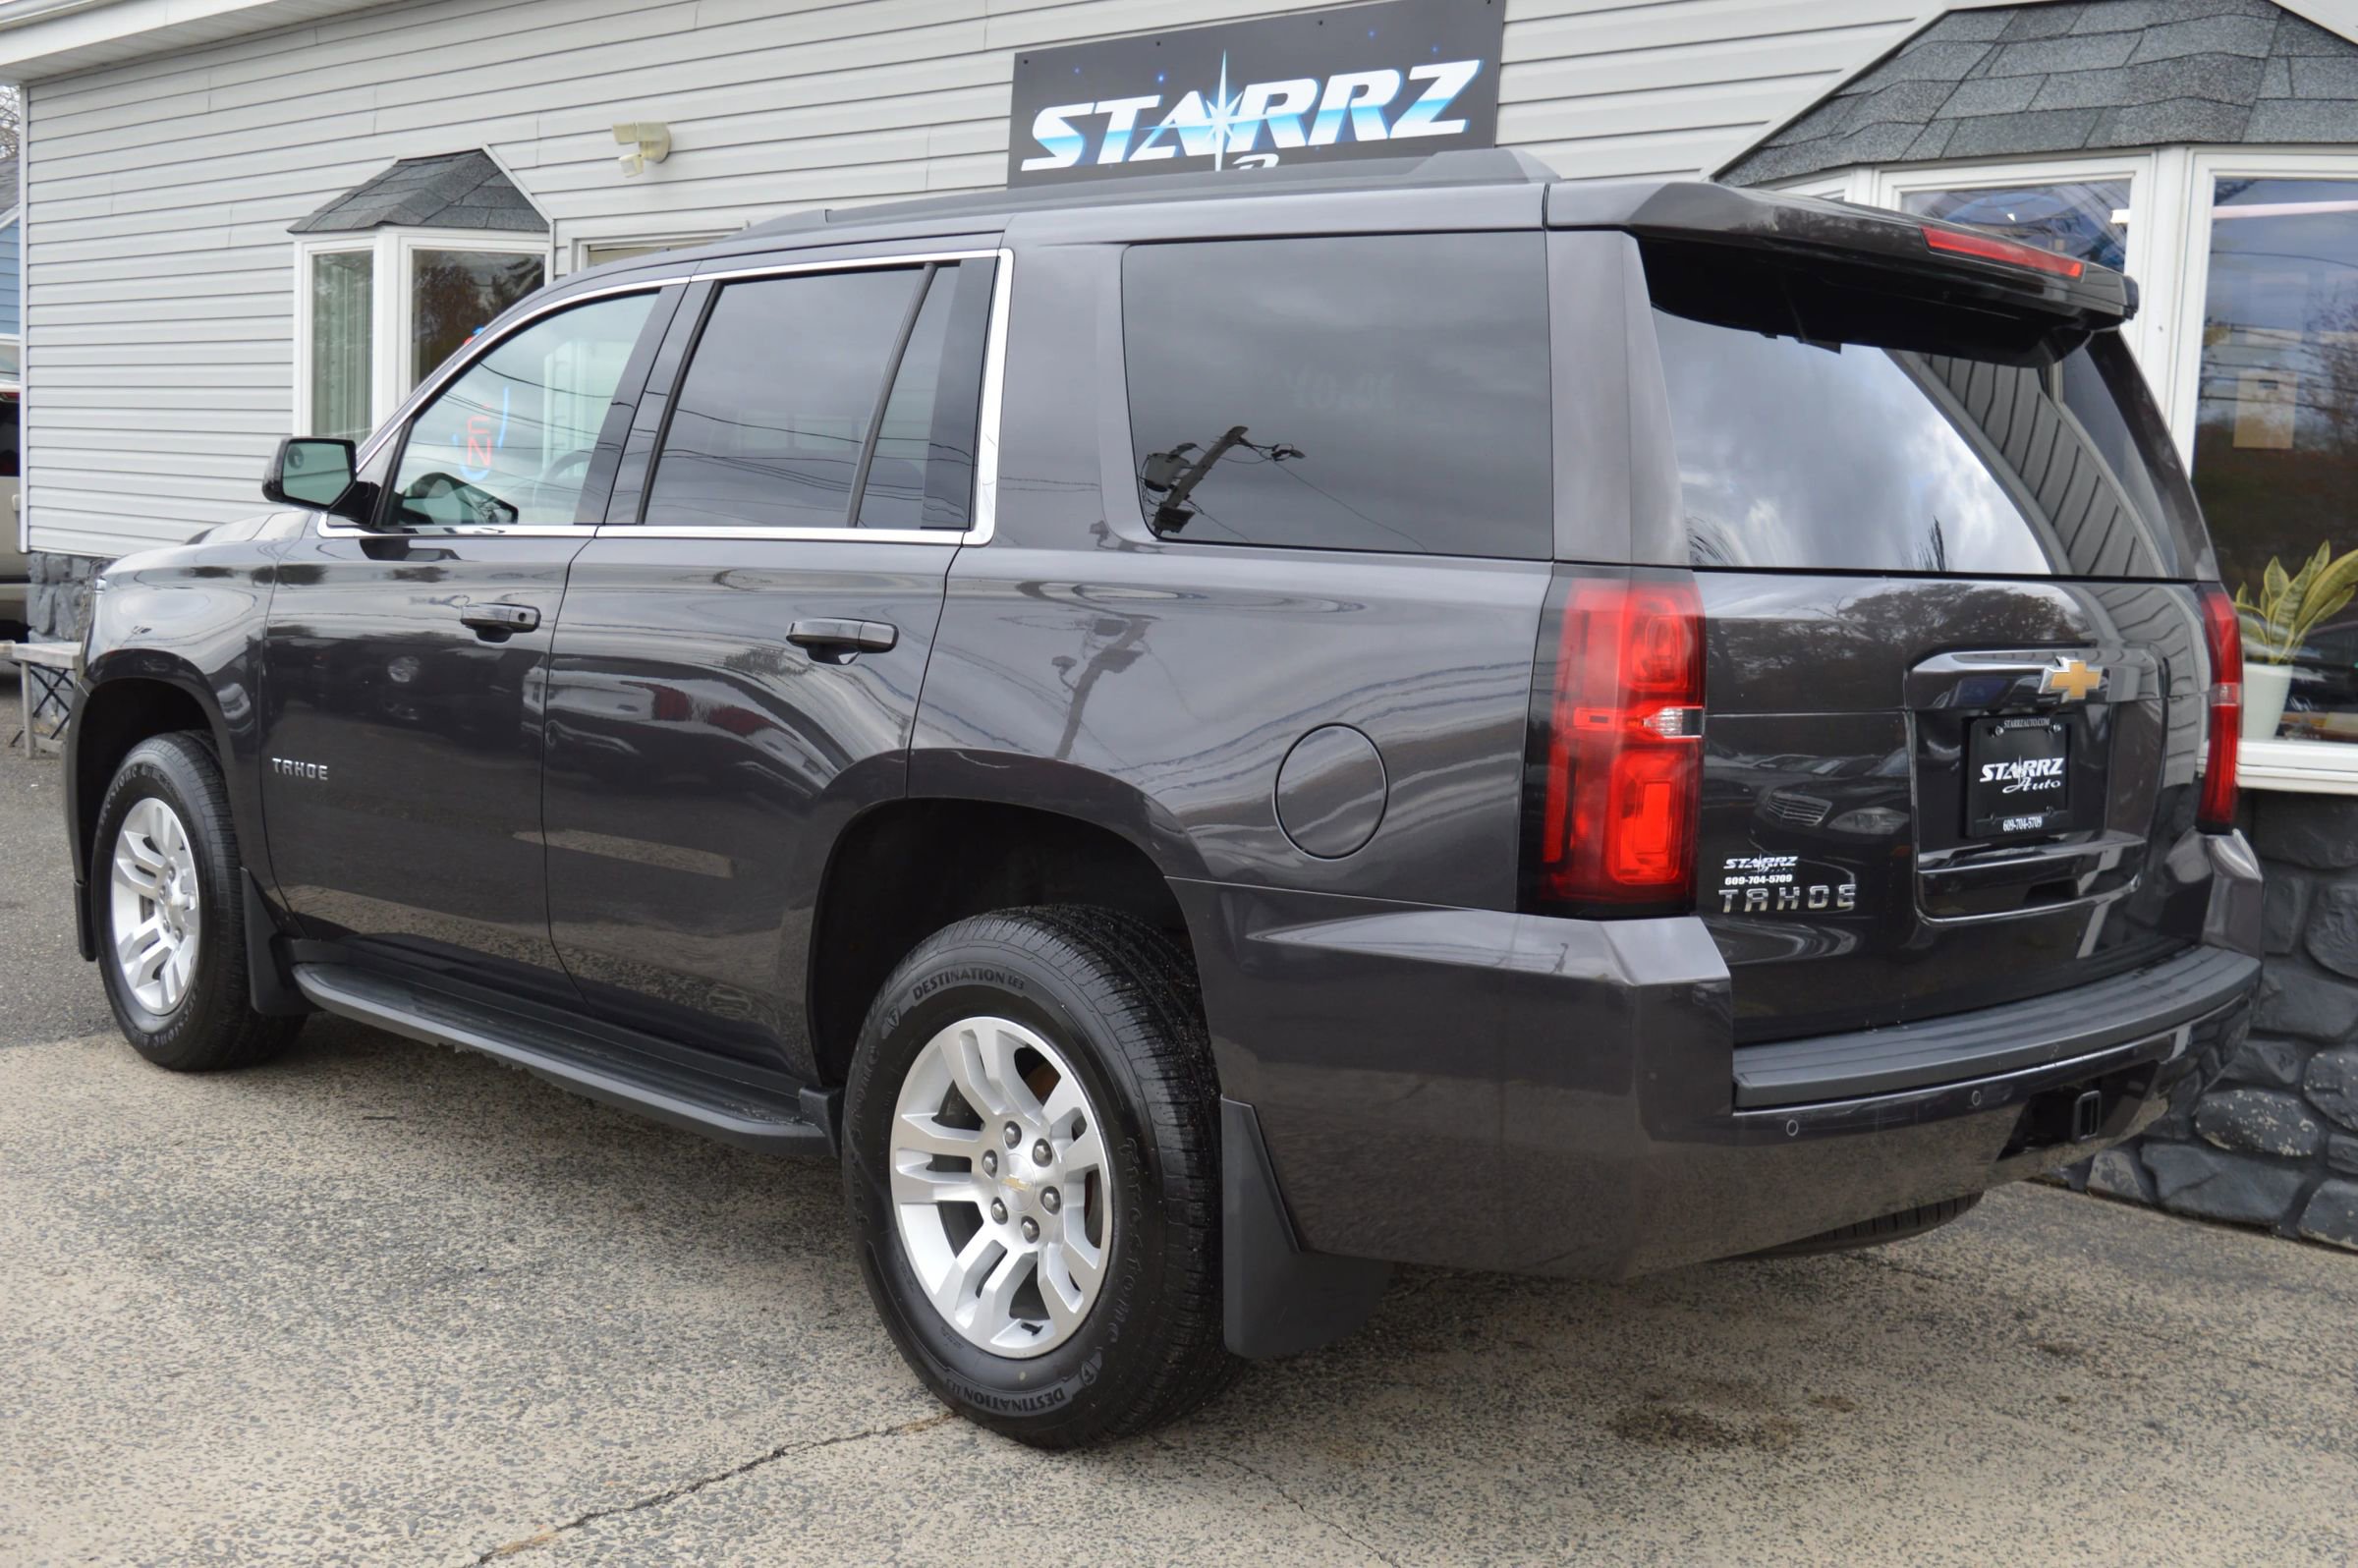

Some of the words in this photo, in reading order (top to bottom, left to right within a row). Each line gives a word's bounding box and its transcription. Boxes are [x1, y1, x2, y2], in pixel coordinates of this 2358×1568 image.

[1020, 57, 1485, 172] STARRZ
[272, 757, 329, 781] TAHOE
[1979, 756, 2064, 783] STARRZ
[2001, 776, 2061, 794] Auto
[2002, 815, 2043, 832] 609-704-5709
[1722, 855, 1799, 870] STARRZ
[1724, 873, 1793, 886] 609-704-5709
[1717, 883, 1857, 914] TAHOE
[913, 967, 1005, 1001] DESTINATION
[963, 1386, 1066, 1412] DESTINATION
